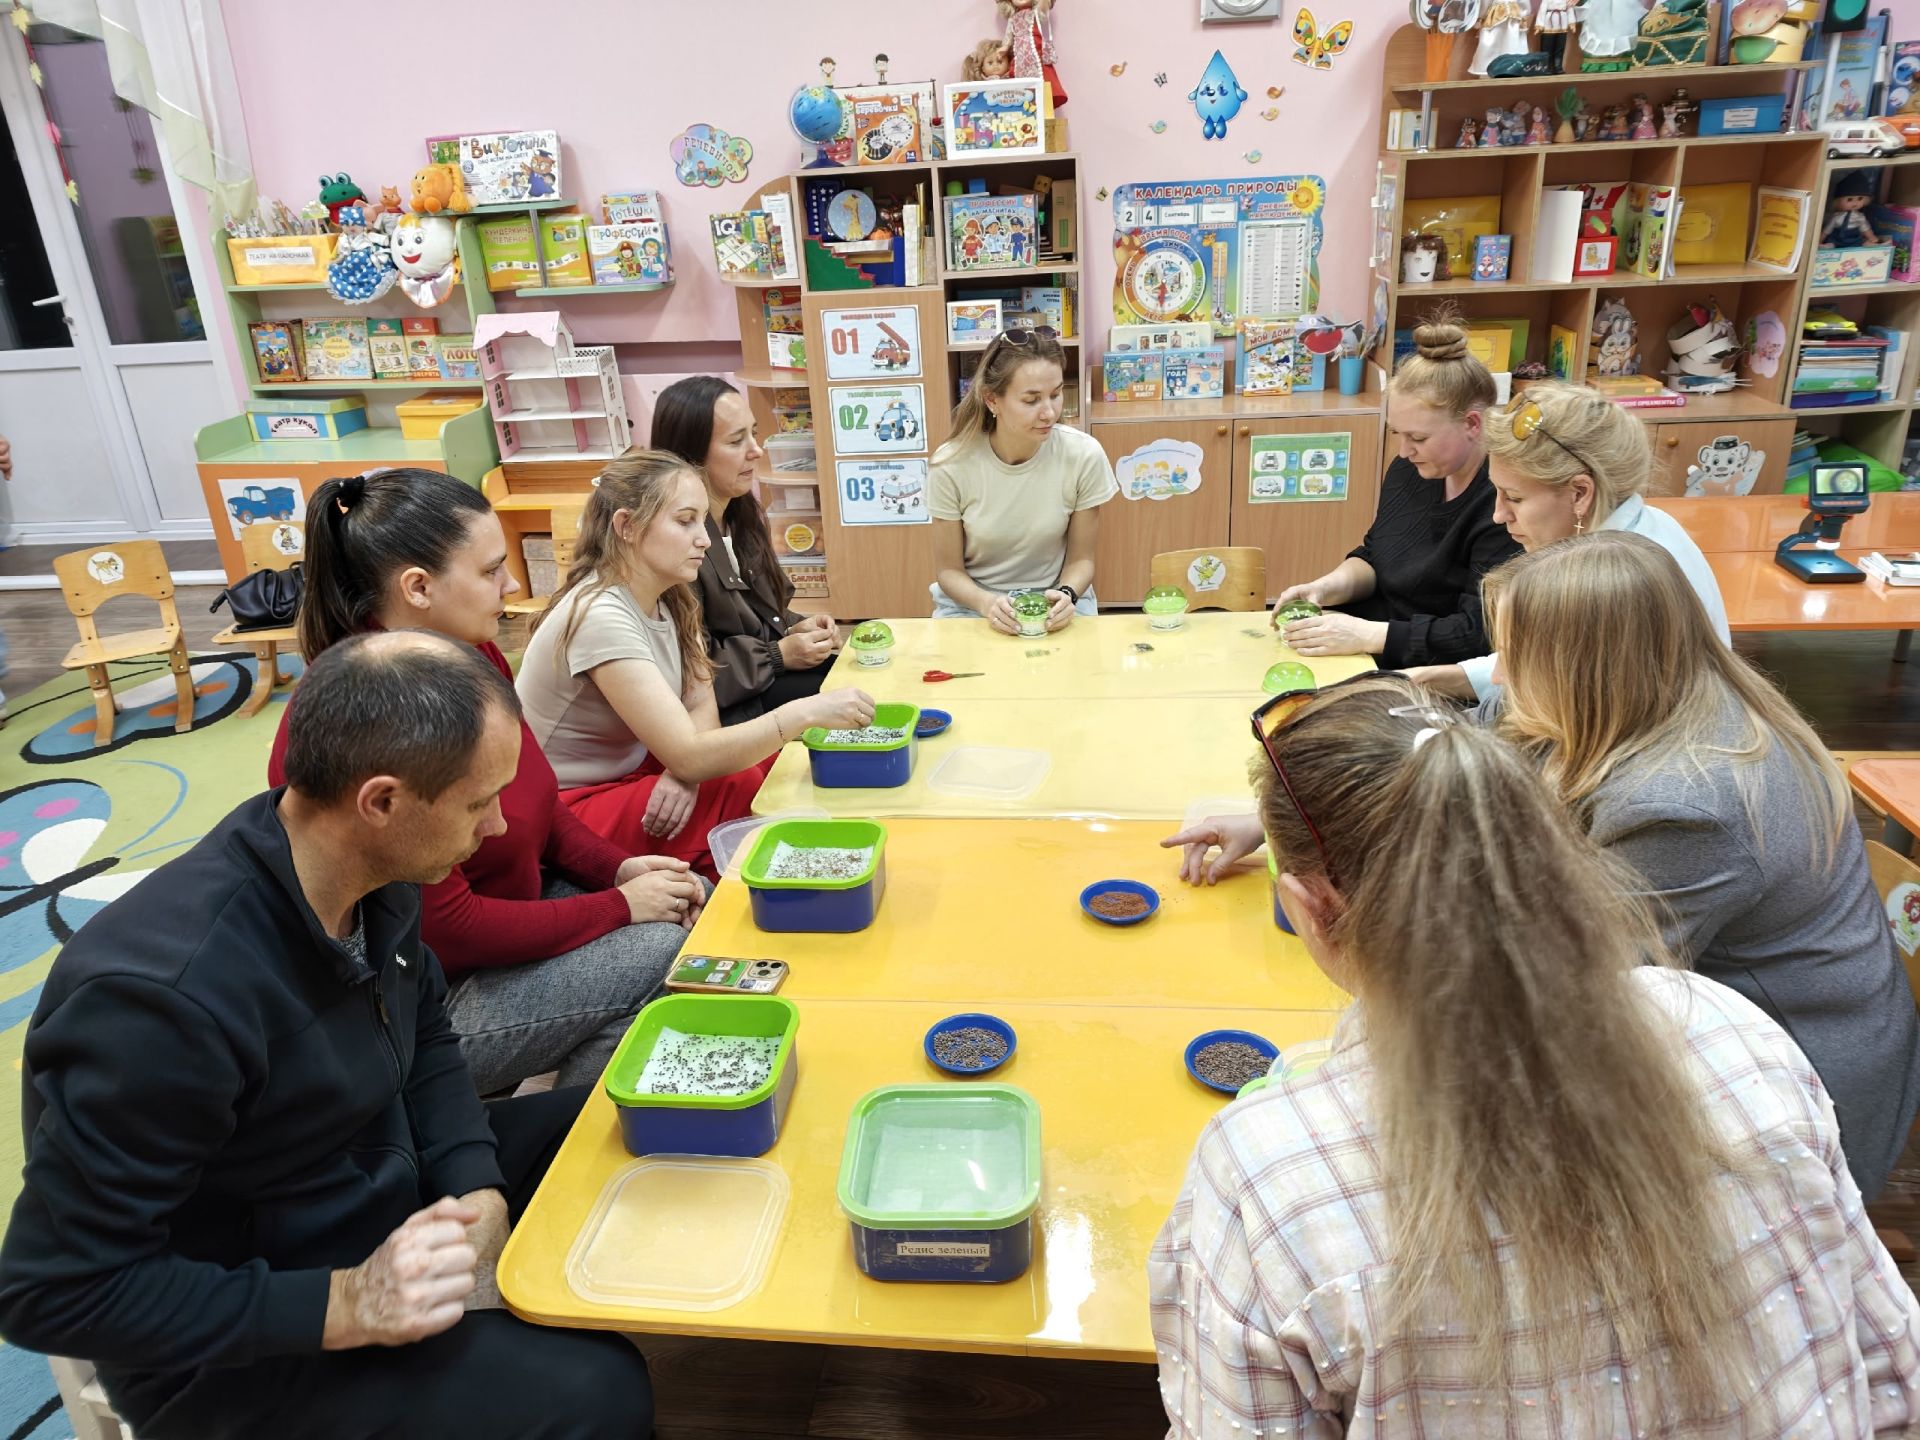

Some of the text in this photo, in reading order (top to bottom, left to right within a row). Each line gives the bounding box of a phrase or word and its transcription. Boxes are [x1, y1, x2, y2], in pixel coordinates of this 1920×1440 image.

[684, 136, 739, 180] РЕЧЕВИЧОК
[1135, 181, 1298, 199] КАЛЕНДАРЬ ПРИРОДЫ
[970, 199, 1017, 208] ПРОФЕССИИ
[1125, 210, 1153, 222] 2 4
[592, 227, 652, 240] ПРОФЕССИИ
[1141, 229, 1191, 242] ВРЕМЯ ГОДА
[1163, 241, 1185, 250] ЗИМА
[248, 253, 267, 261] ТЕАТР
[1125, 262, 1136, 287] ОСЕНЬ
[1144, 312, 1163, 321] ЛЕТО
[831, 327, 860, 355] 01
[1249, 328, 1291, 345] МОЙ ДОМ
[446, 349, 478, 360] ЛОТО
[838, 404, 869, 431] 02
[293, 416, 319, 435] кукол
[846, 476, 875, 501] 03
[901, 1245, 987, 1255] Редис зеленый
